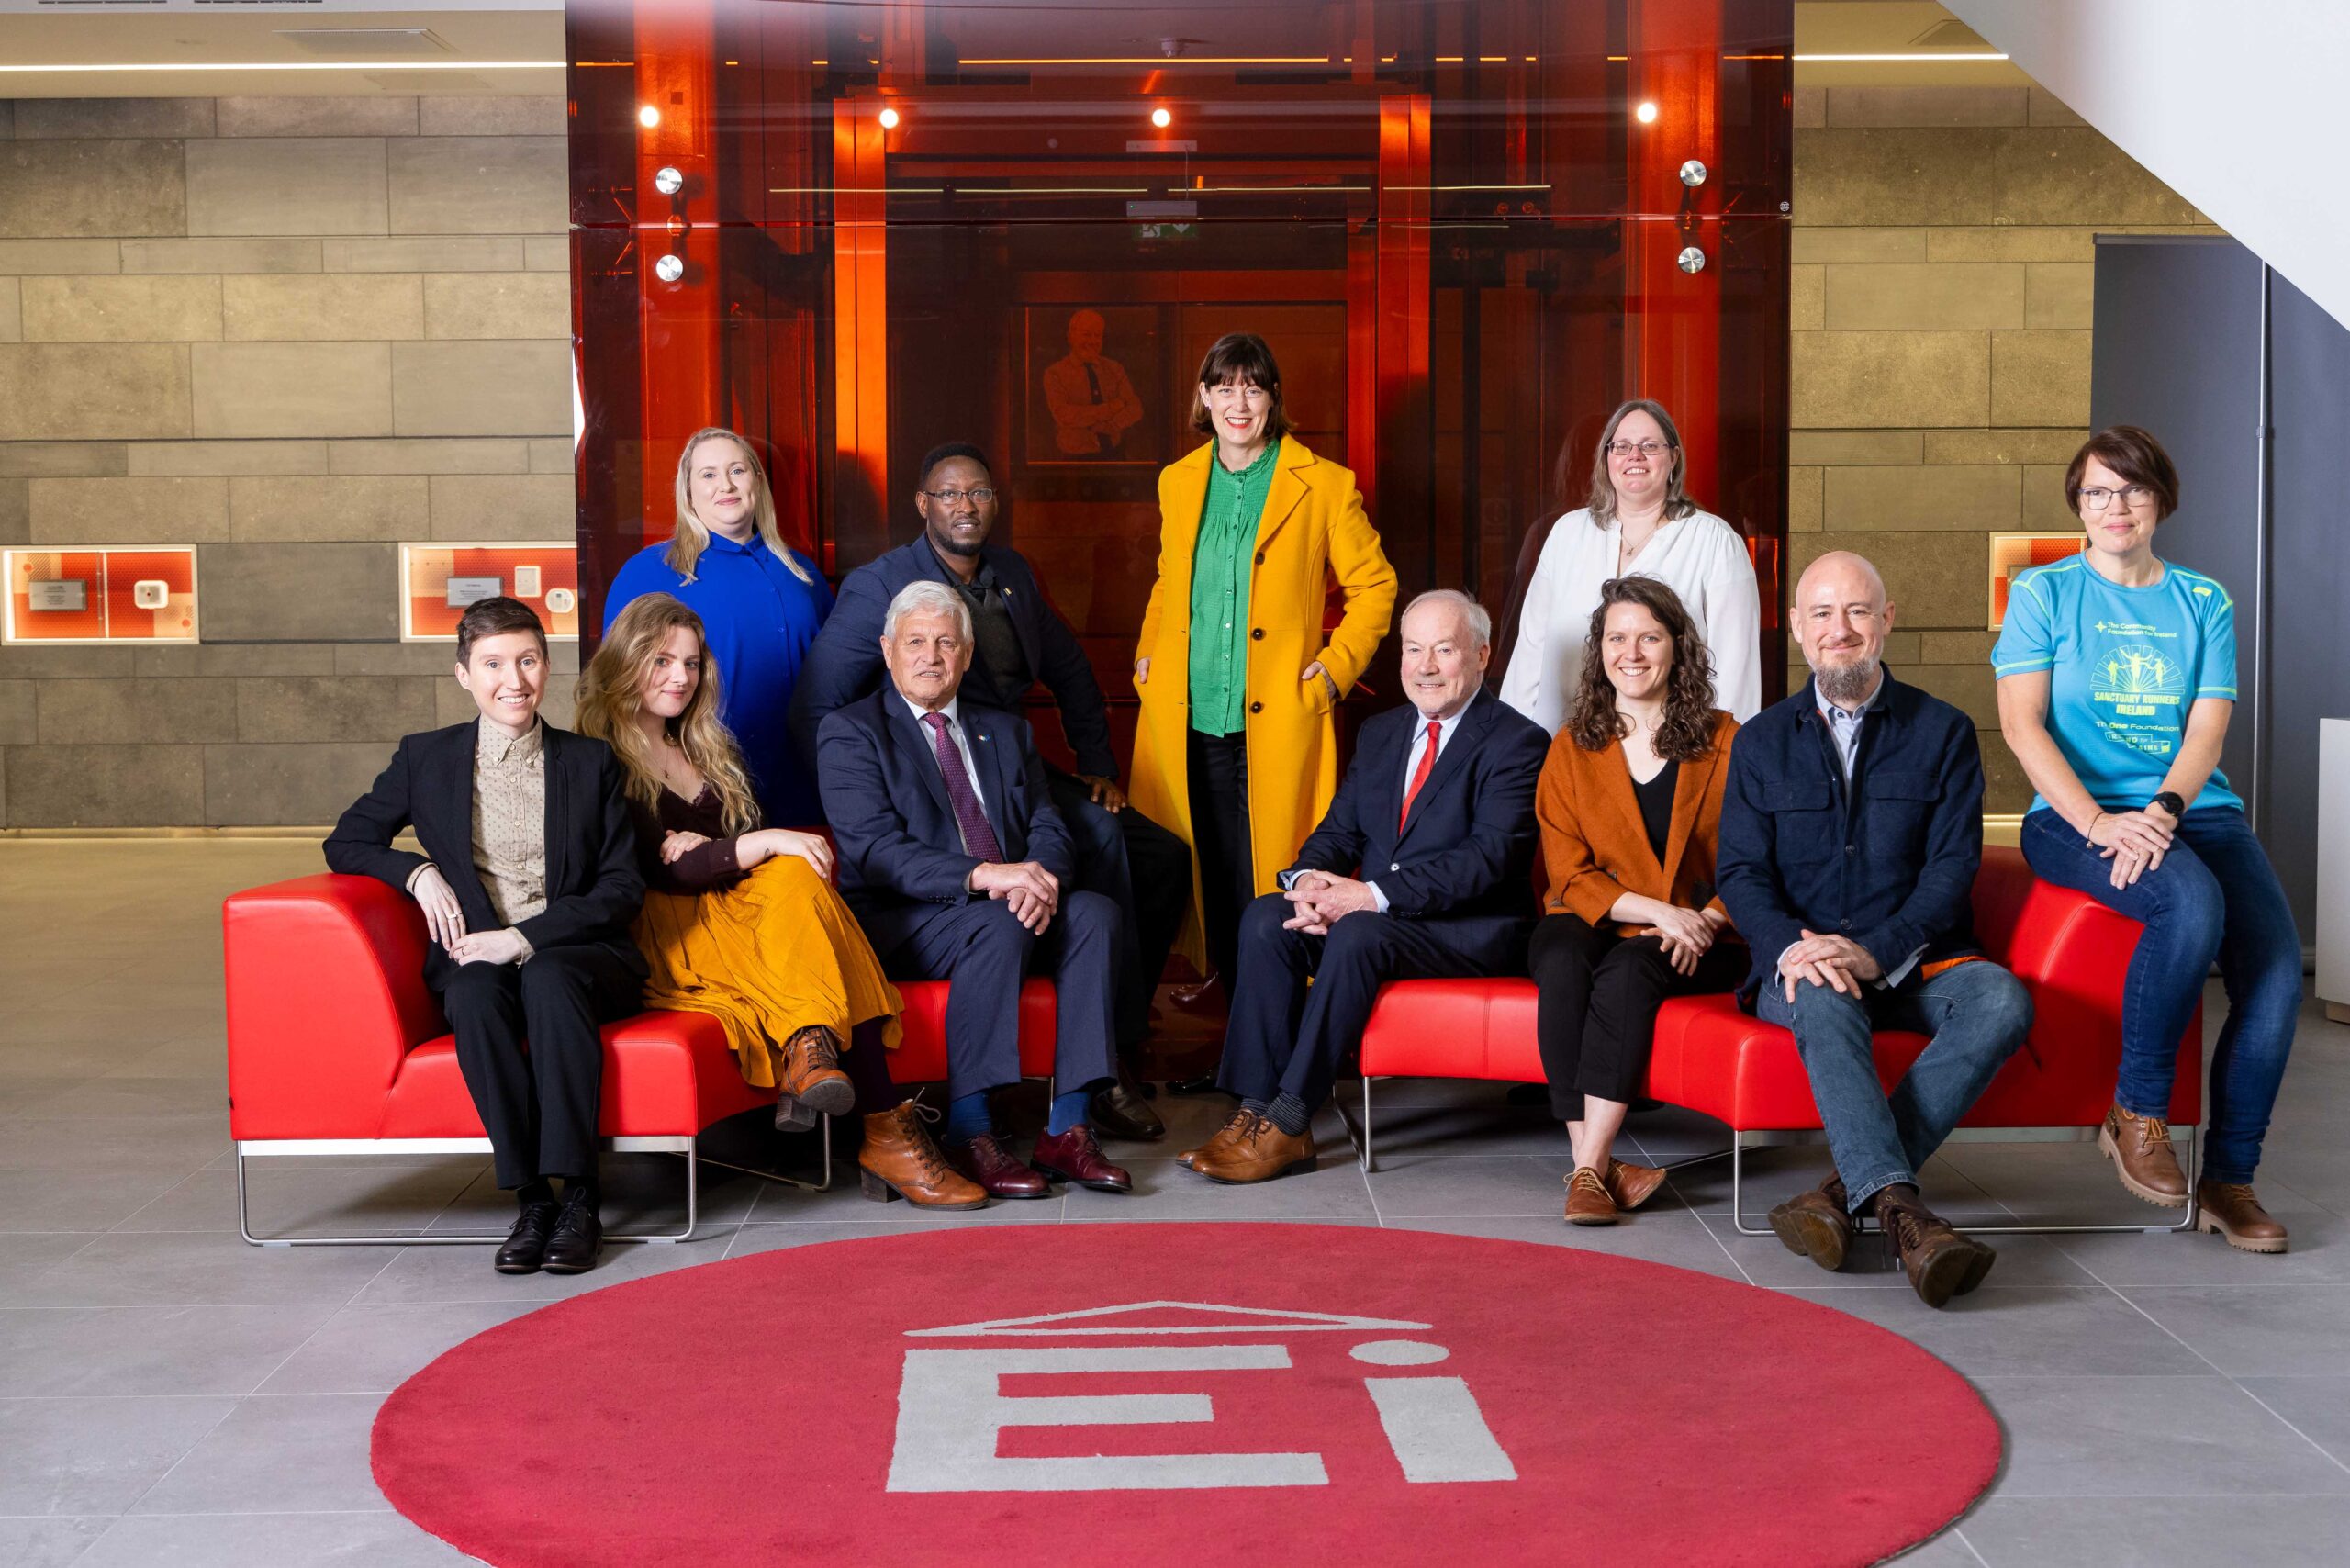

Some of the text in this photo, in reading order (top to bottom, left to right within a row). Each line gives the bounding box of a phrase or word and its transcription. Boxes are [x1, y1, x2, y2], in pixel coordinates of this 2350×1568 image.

[2120, 623, 2156, 632] Community
[2094, 691, 2180, 705] SANCTUARY RUNNERS
[2116, 704, 2155, 716] IRELAND
[2130, 723, 2179, 732] Foundation
